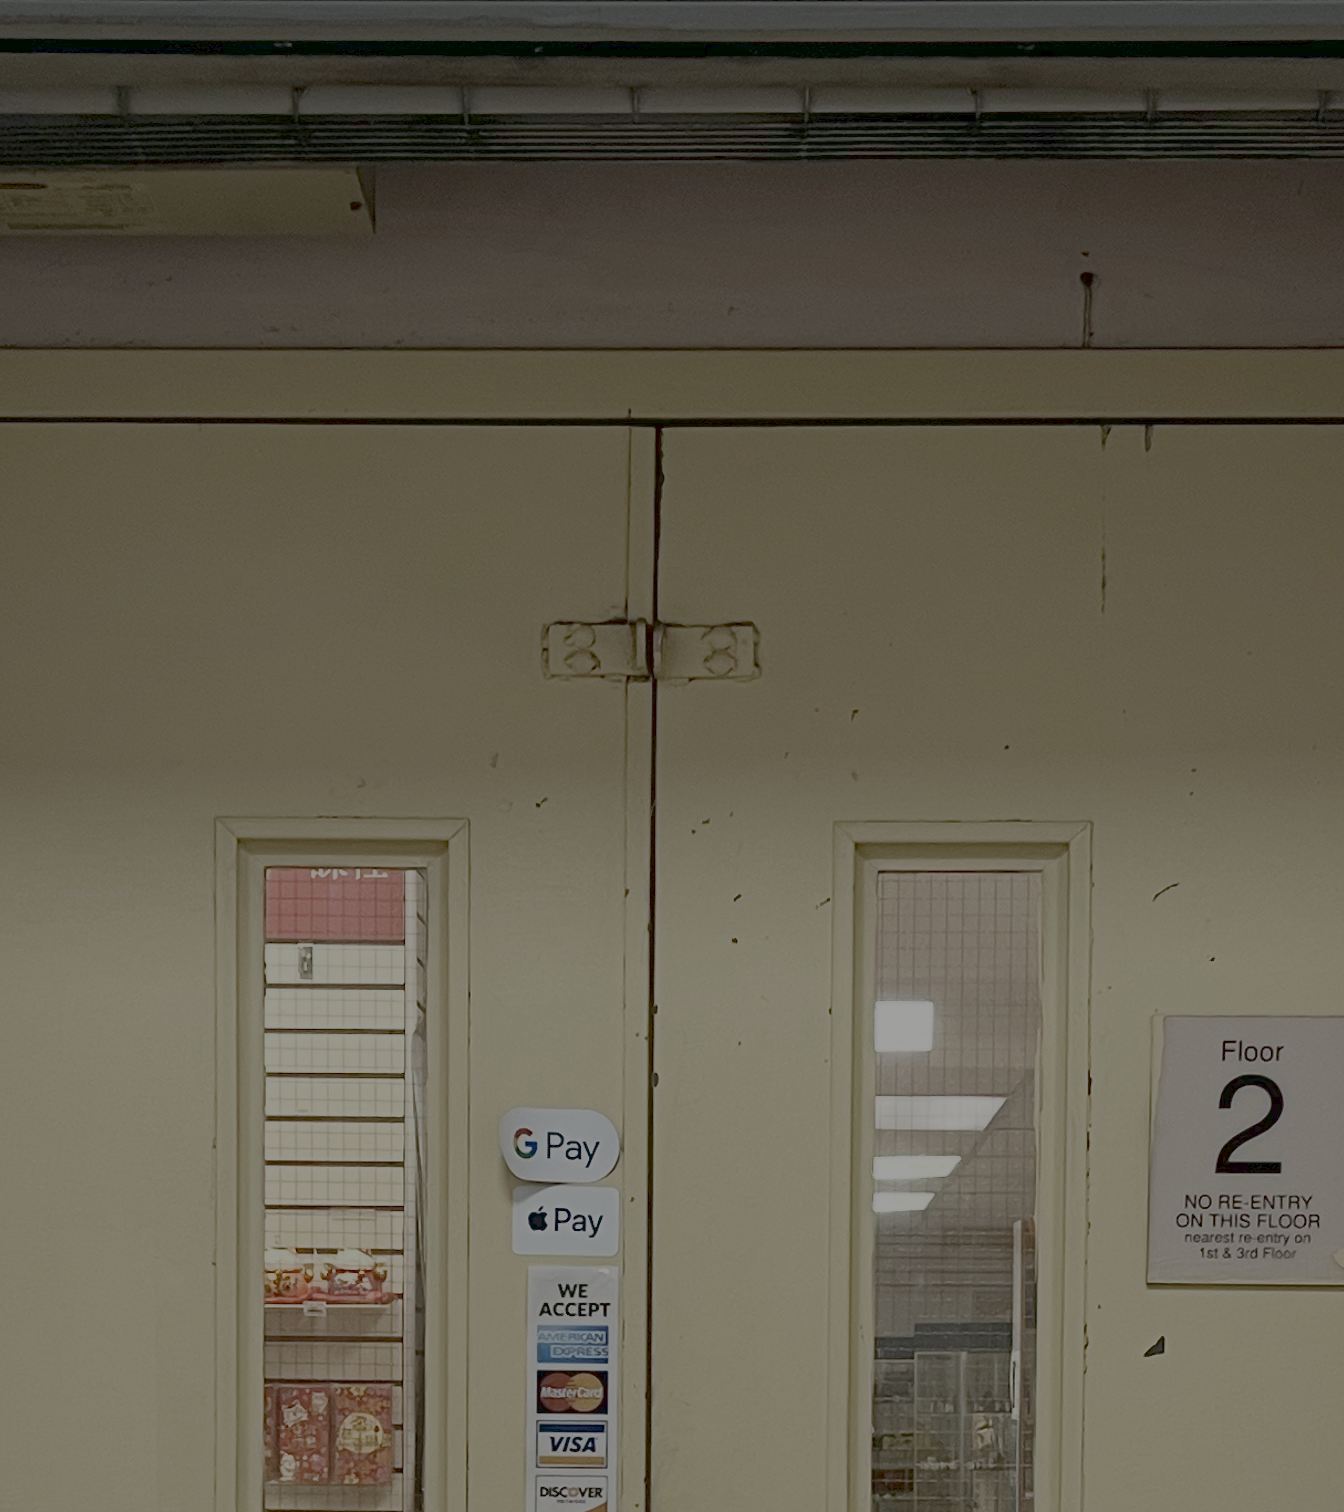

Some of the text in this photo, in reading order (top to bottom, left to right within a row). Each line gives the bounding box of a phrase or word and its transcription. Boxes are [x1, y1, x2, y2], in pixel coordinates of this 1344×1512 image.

[1221, 1040, 1285, 1062] Floor
[1215, 1074, 1284, 1174] 2
[514, 1128, 600, 1168] G Pay
[1184, 1194, 1313, 1210] NO RE-ENTRY
[554, 1208, 603, 1238] Pay
[1176, 1213, 1320, 1229] ON THIS FLOOR
[1184, 1232, 1311, 1246] nearest re-entry on
[1200, 1247, 1297, 1259] 1st & 3rd Floor
[558, 1284, 588, 1298] WE
[539, 1302, 611, 1317] ACCEPT
[538, 1333, 604, 1342] AMERICAN
[540, 1387, 603, 1399] MasterCard
[549, 1436, 597, 1453] VISA
[539, 1486, 604, 1499] DISCOVER
